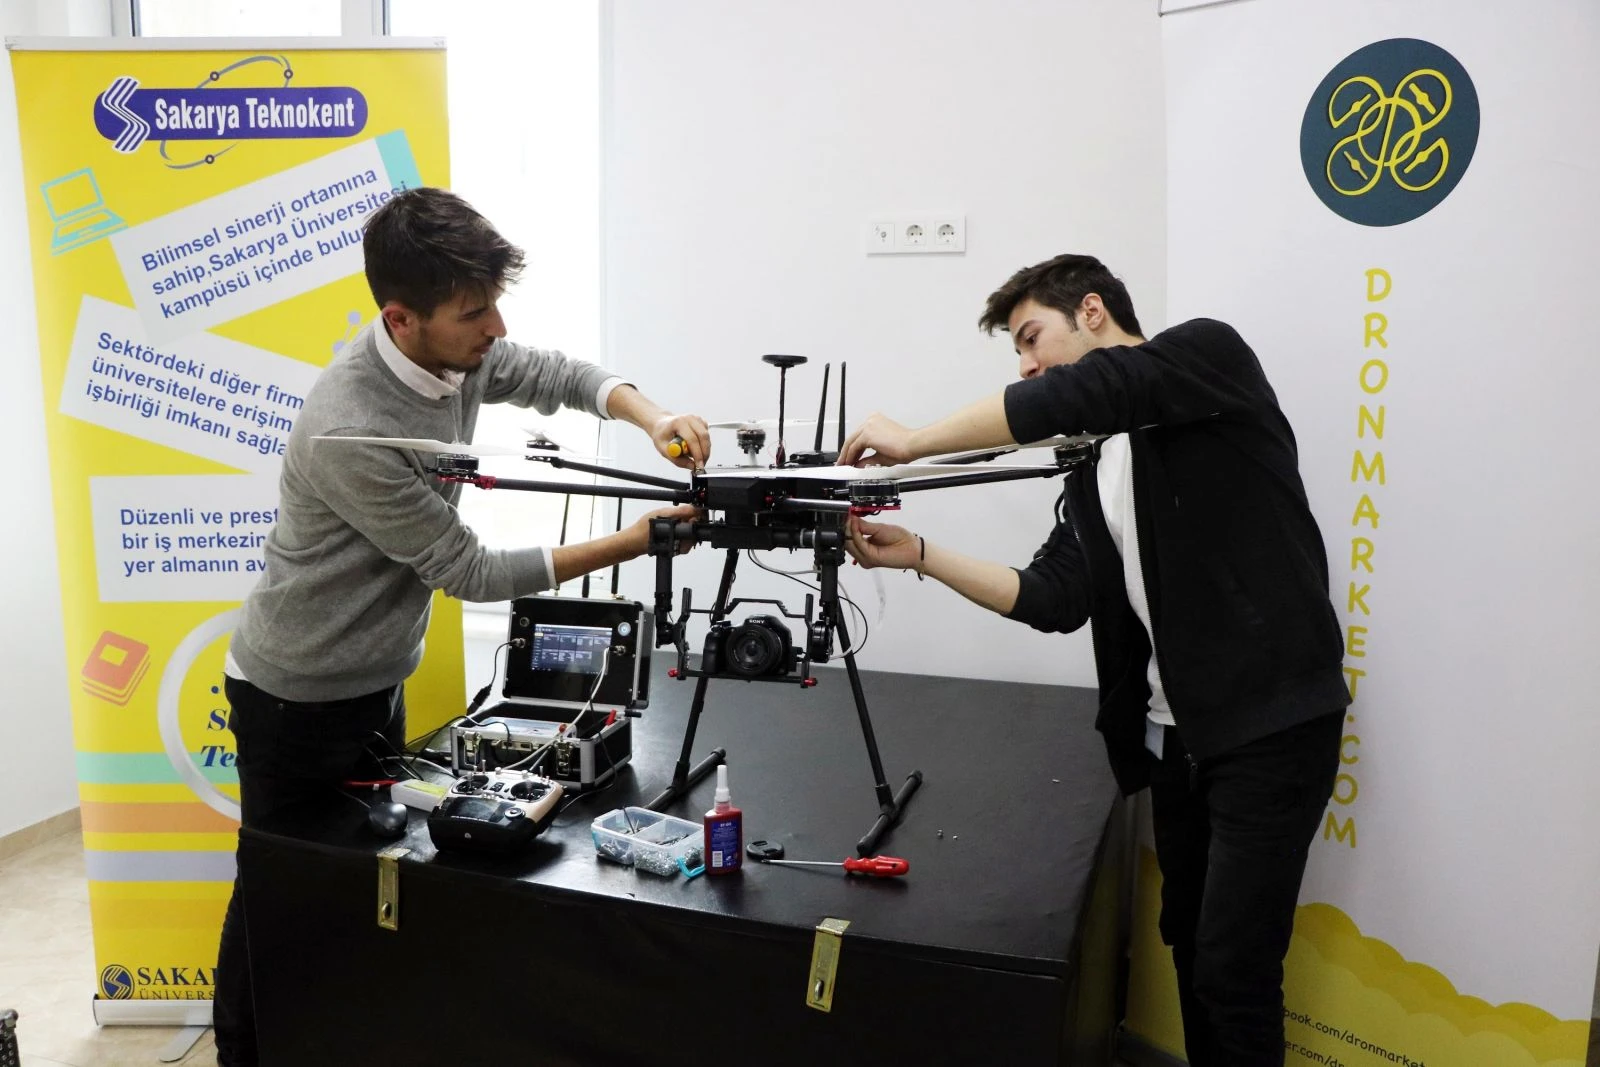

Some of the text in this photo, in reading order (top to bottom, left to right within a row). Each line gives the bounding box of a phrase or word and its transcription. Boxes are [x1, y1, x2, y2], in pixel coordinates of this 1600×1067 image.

[155, 97, 354, 136] Sakarya Teknokent
[141, 169, 378, 272] Bilimsel sinerji ortamına
[160, 271, 251, 319] kampüsü
[253, 249, 314, 284] içinde
[91, 356, 293, 433] üniversitelere erişim
[97, 332, 304, 411] Sektördeki diğer firm
[86, 379, 161, 418] işbirliği
[165, 404, 231, 439] imkanı
[120, 507, 195, 526] Düzenli
[201, 511, 223, 525] ve
[122, 532, 149, 550] bir
[155, 533, 172, 553] iş
[123, 560, 155, 577] yer
[161, 557, 239, 573] almanın
[200, 745, 239, 768] Te
